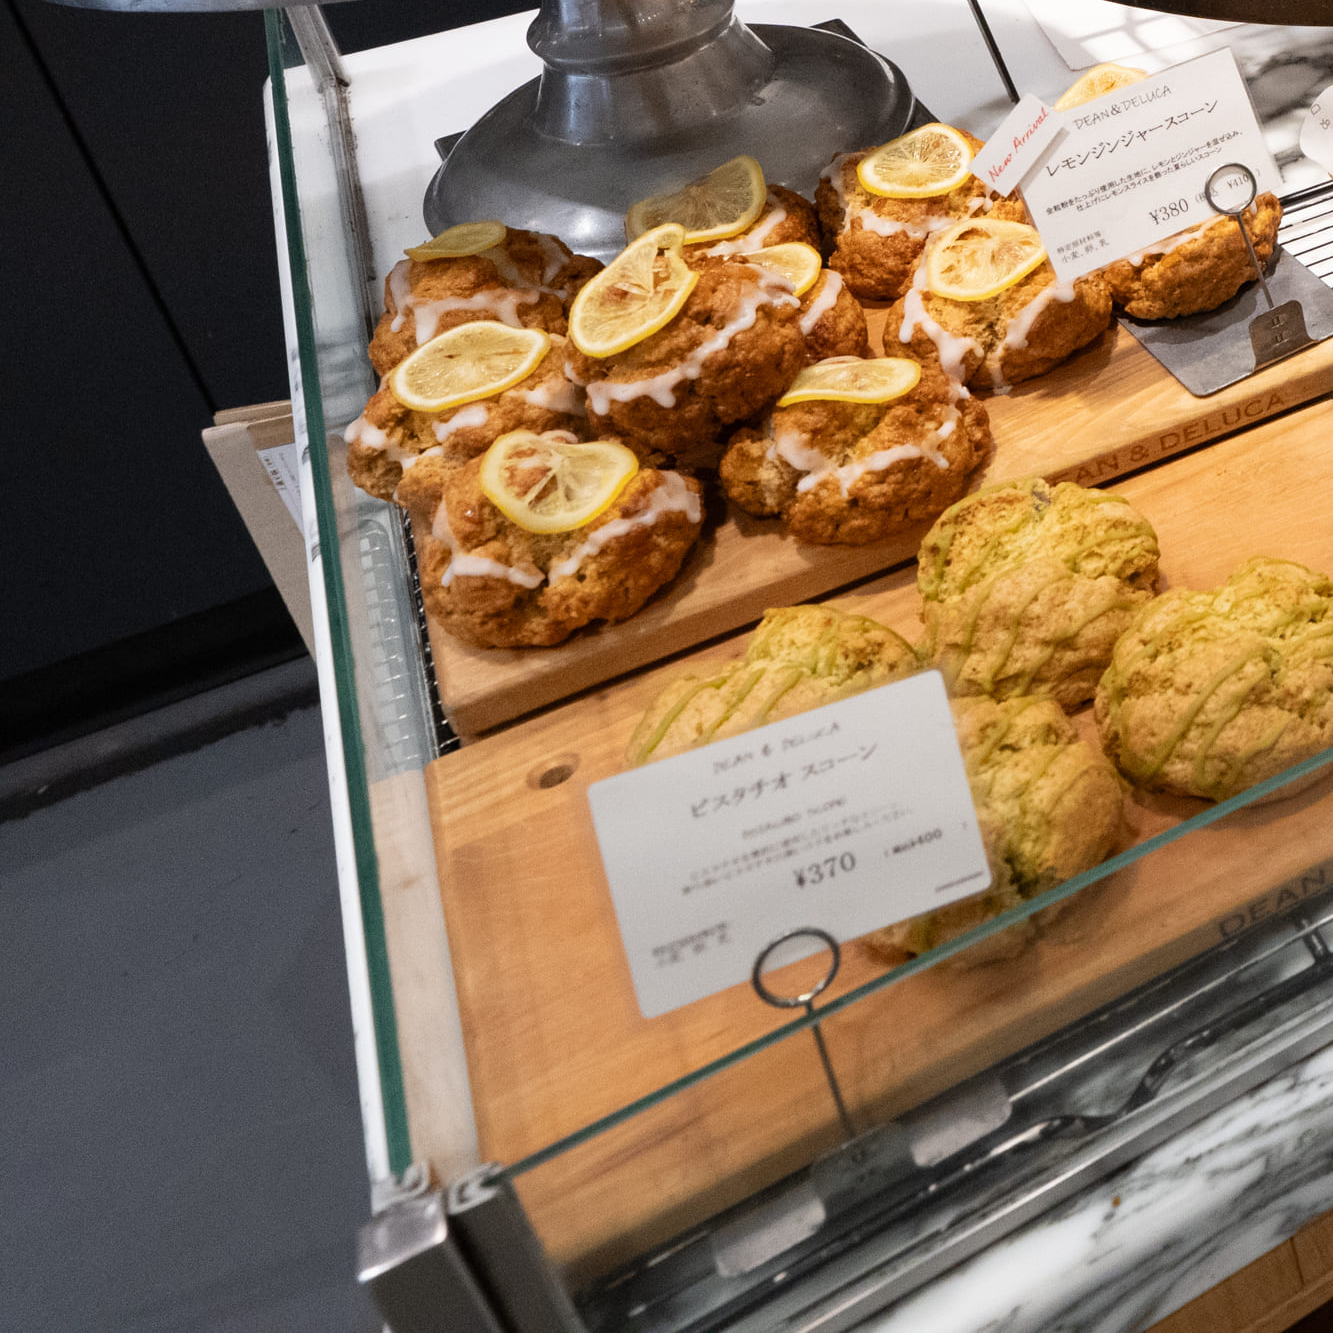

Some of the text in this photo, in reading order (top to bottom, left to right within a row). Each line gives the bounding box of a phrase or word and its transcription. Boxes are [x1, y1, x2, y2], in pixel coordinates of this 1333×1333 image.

[1046, 100, 1219, 178] レモンジンジャースコーン
[1074, 84, 1172, 130] DEAN&DELUCA
[987, 107, 1049, 182] New Arrival
[1149, 198, 1189, 226] ¥380
[1129, 445, 1149, 462] &
[1159, 393, 1285, 452] DELUCA
[690, 743, 879, 819] ピスタチオ スコーン
[793, 851, 857, 890] ¥370
[1218, 868, 1328, 940] DEAN
